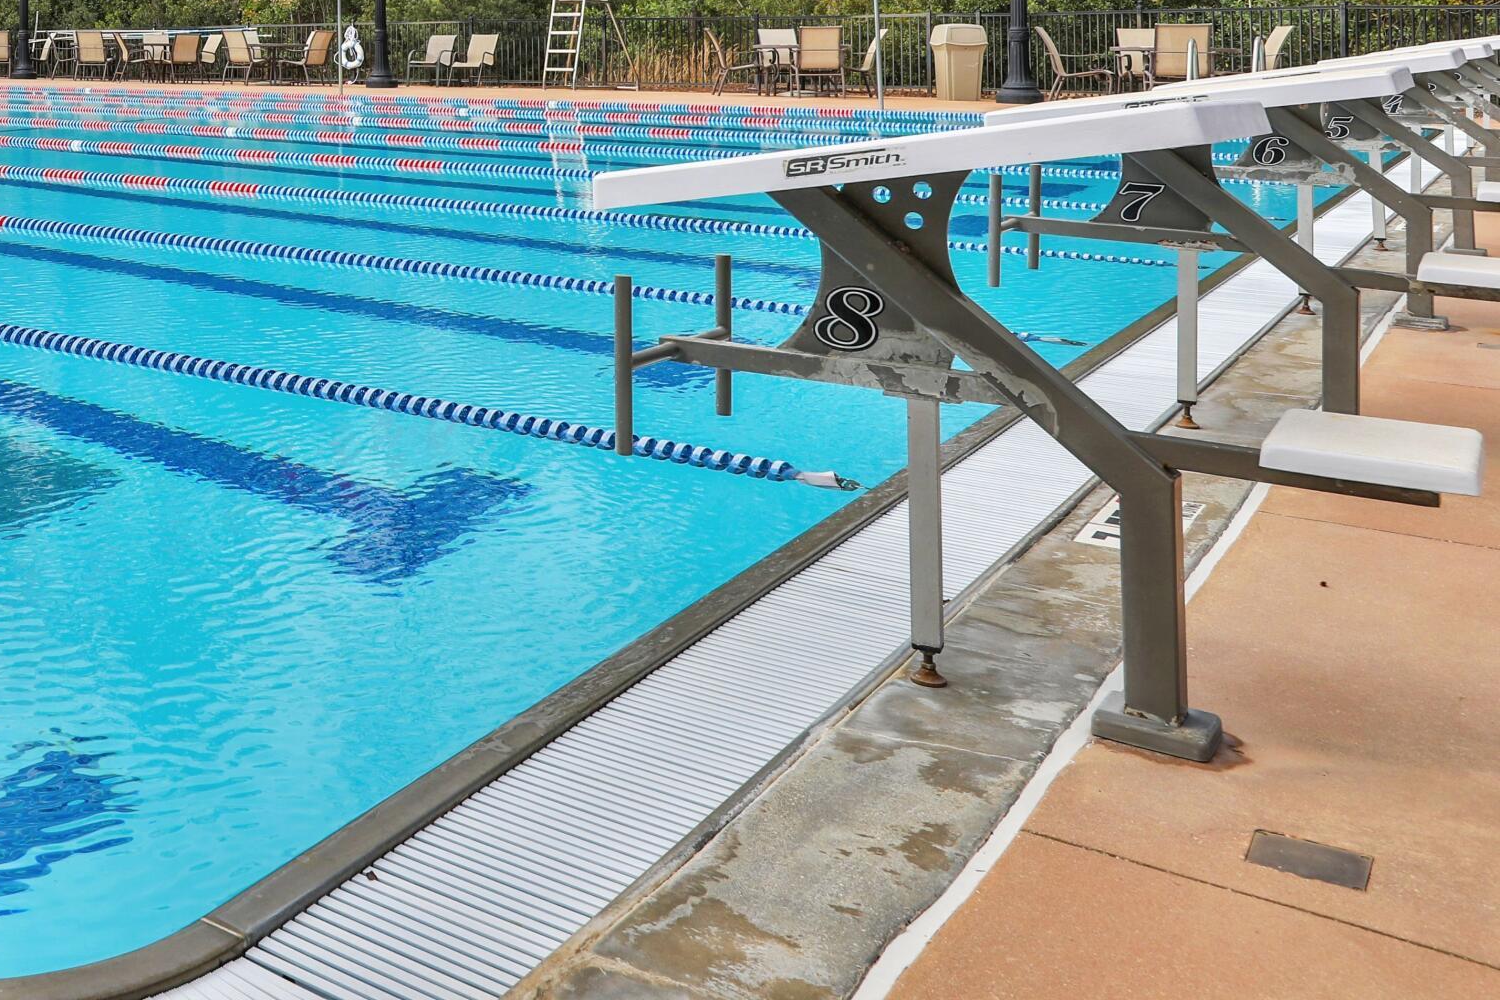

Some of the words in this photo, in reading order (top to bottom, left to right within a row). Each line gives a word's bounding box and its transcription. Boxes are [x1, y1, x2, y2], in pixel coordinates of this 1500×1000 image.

[1324, 116, 1354, 140] 5
[1252, 136, 1290, 166] 6
[1118, 181, 1166, 222] 7
[814, 286, 884, 352] 8
